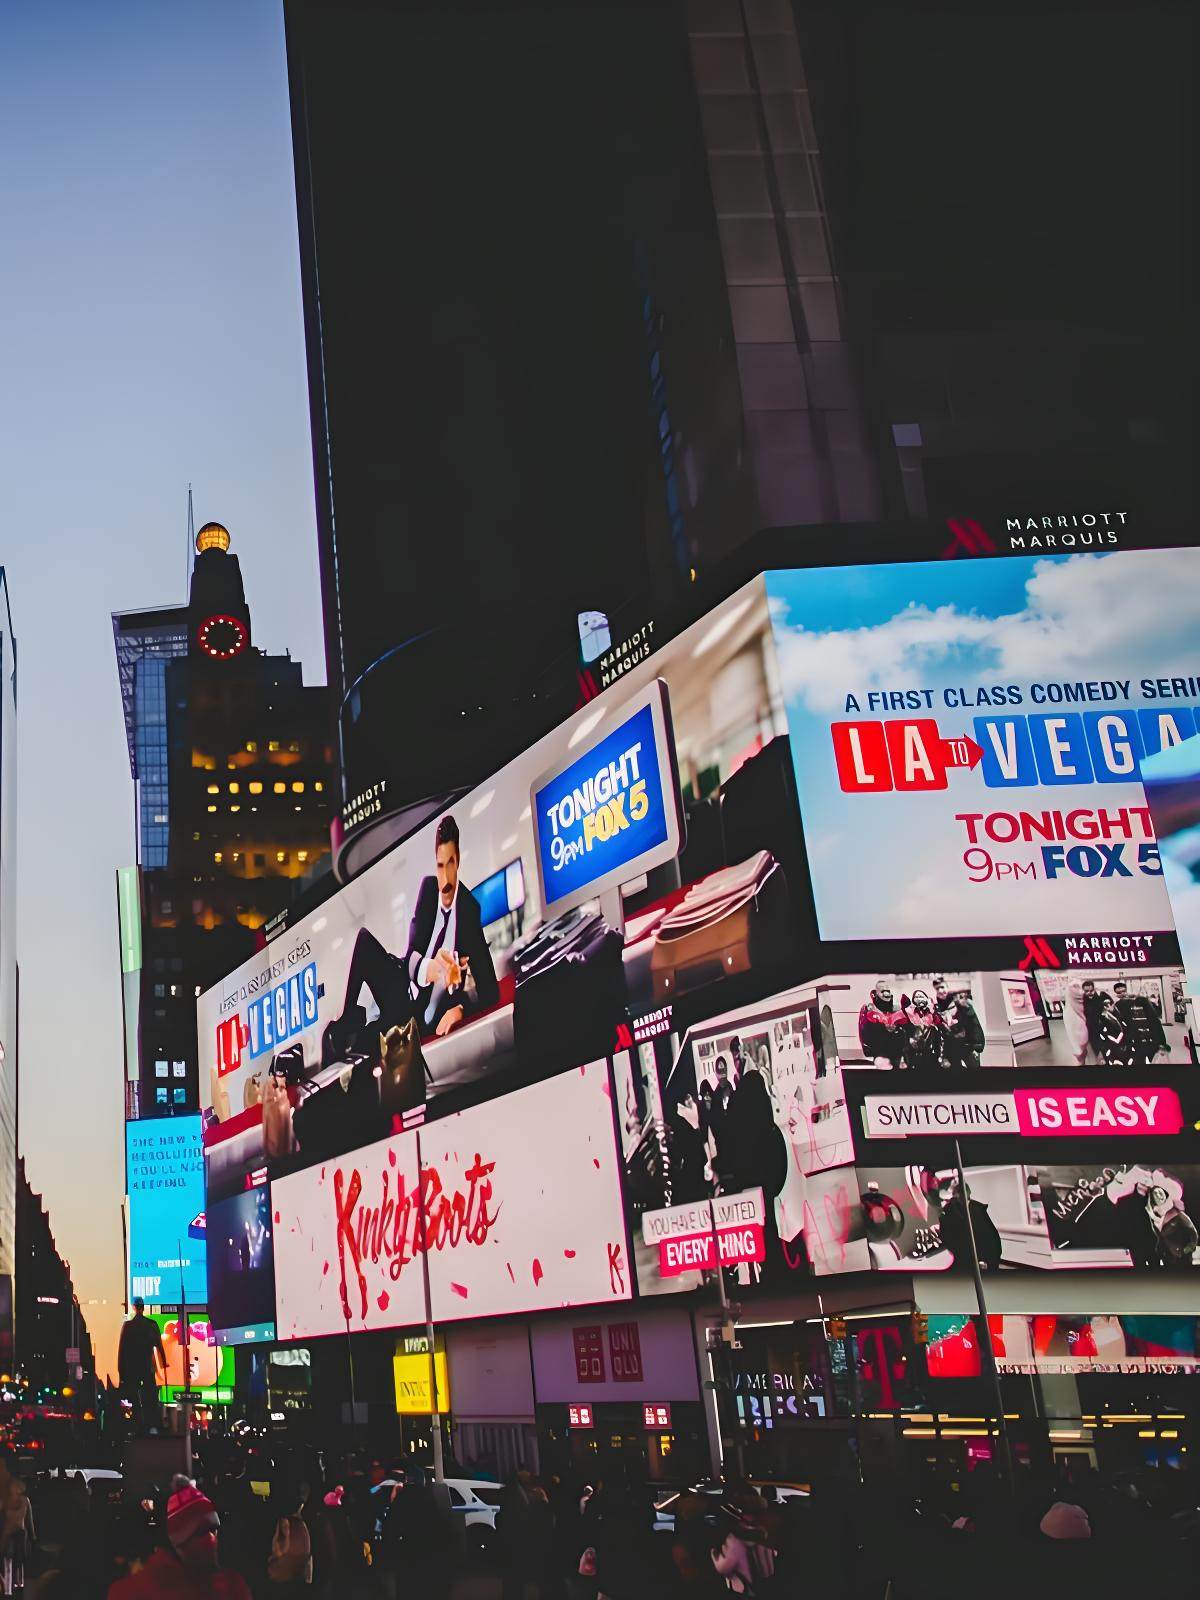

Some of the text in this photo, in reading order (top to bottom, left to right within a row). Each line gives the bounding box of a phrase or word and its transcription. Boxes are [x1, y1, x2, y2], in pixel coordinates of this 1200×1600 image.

[1006, 512, 1127, 530] MARRIOTT
[1010, 531, 1118, 548] MARQUIS
[845, 677, 1200, 712] A FIRST CLASS COMEDY SERI
[848, 714, 1186, 784] LA TO VEGA
[547, 742, 642, 837] TONIGHT
[583, 792, 630, 851] FOX
[630, 779, 649, 821] 5
[955, 807, 1155, 844] TONIGHT
[963, 843, 1164, 883] 9PM FOX 5
[1064, 936, 1154, 949] MARRIOTT
[1068, 950, 1147, 963] MARQUIS
[249, 966, 317, 1056] VEGAS
[877, 1103, 1011, 1126] SWITCHING
[1027, 1095, 1159, 1128] IS EASY
[333, 1152, 504, 1321] Kinky Boots
[666, 1230, 757, 1267] EVERYHING
